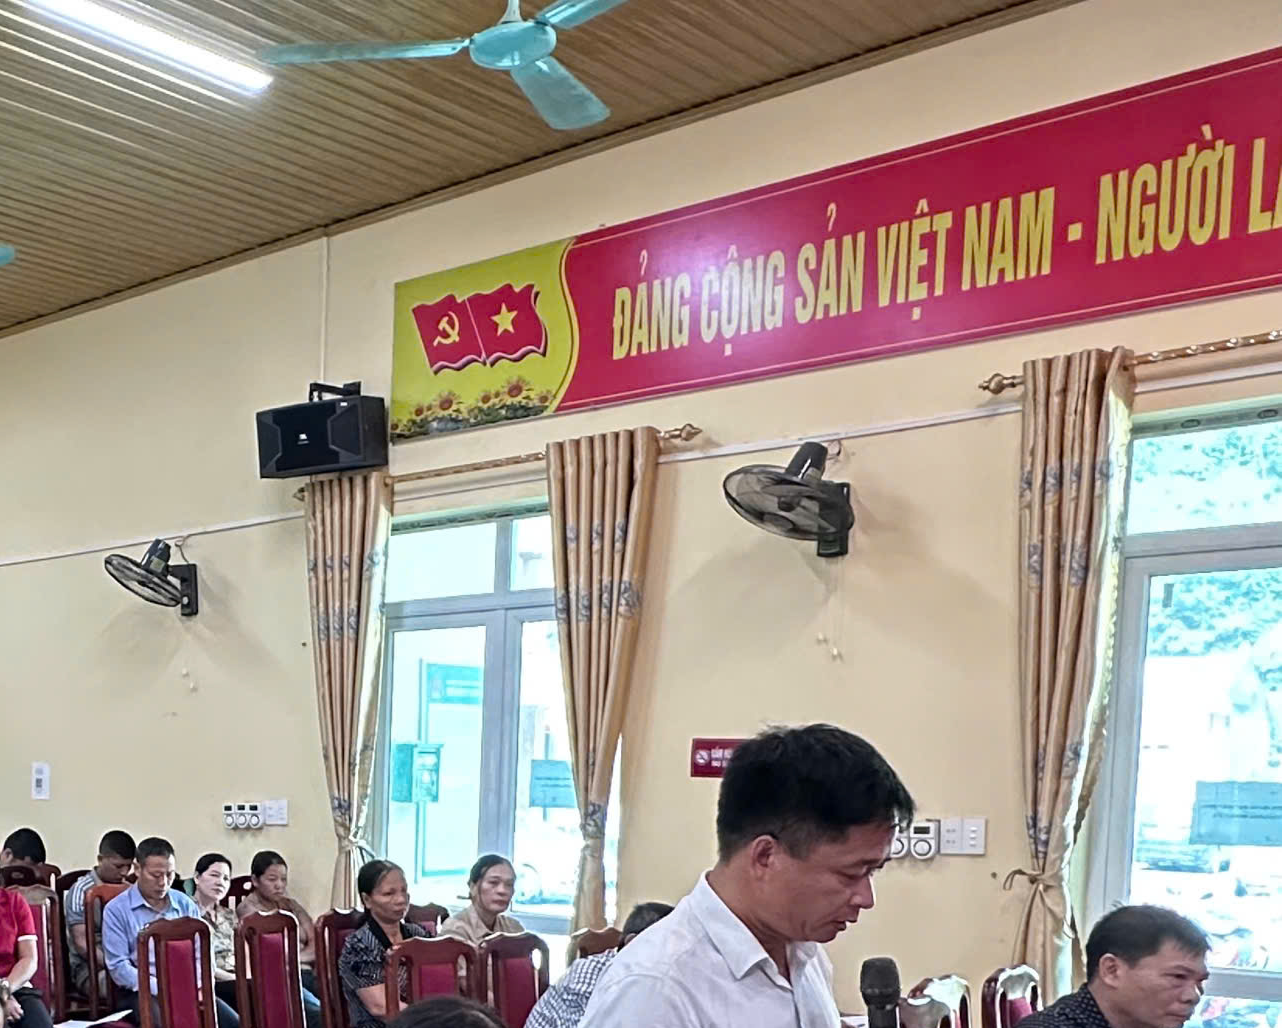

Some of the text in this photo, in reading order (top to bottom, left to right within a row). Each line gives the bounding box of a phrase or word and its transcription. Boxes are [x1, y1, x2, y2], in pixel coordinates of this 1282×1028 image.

[612, 249, 691, 360] ĐẢNG
[699, 245, 786, 357] CỘNG
[794, 203, 866, 325] SẢN
[877, 198, 953, 321] VIỆT
[961, 186, 1055, 291] NAM
[1095, 123, 1236, 265] NGƯỜI
[1248, 136, 1282, 234] L
